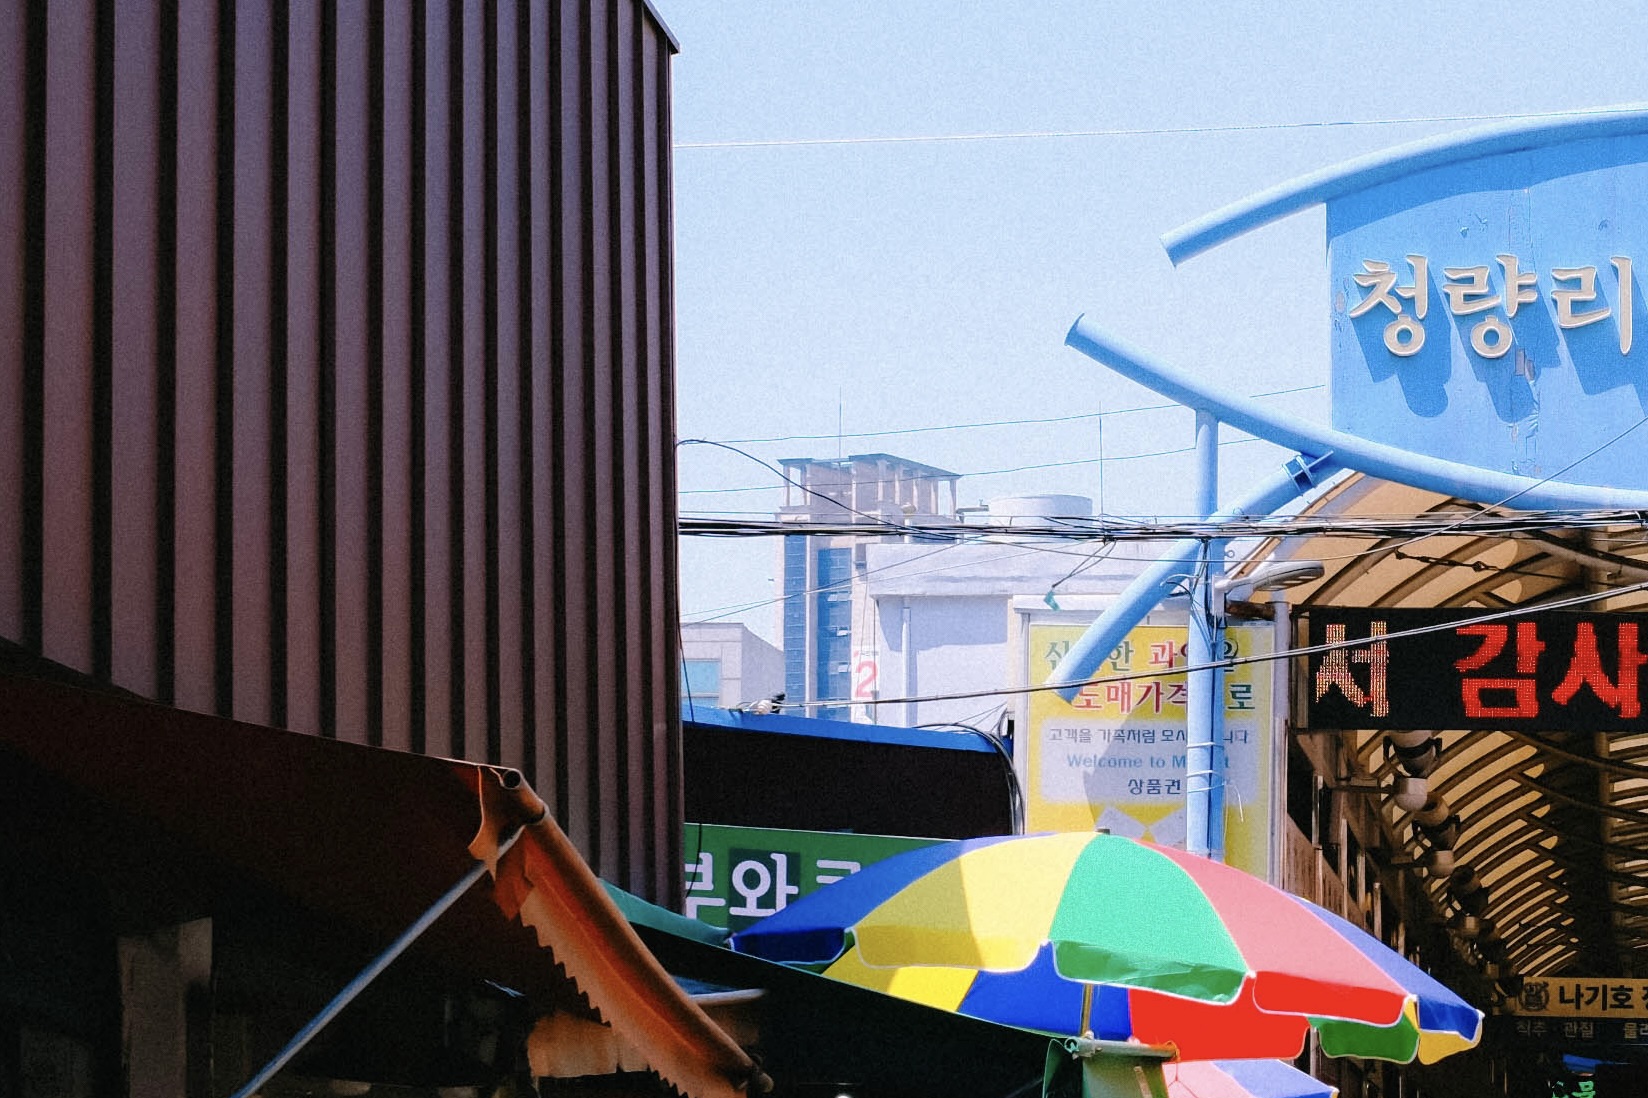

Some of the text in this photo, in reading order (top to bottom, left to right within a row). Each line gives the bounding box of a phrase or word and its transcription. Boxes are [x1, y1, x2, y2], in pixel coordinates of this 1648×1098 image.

[1045, 640, 1135, 673] 신한
[1100, 728, 1157, 745] 가족처럼
[1066, 753, 1143, 769] Welcome
[1150, 754, 1166, 768] to
[1127, 777, 1181, 796] 상품권
[1558, 984, 1634, 1012] 나기호
